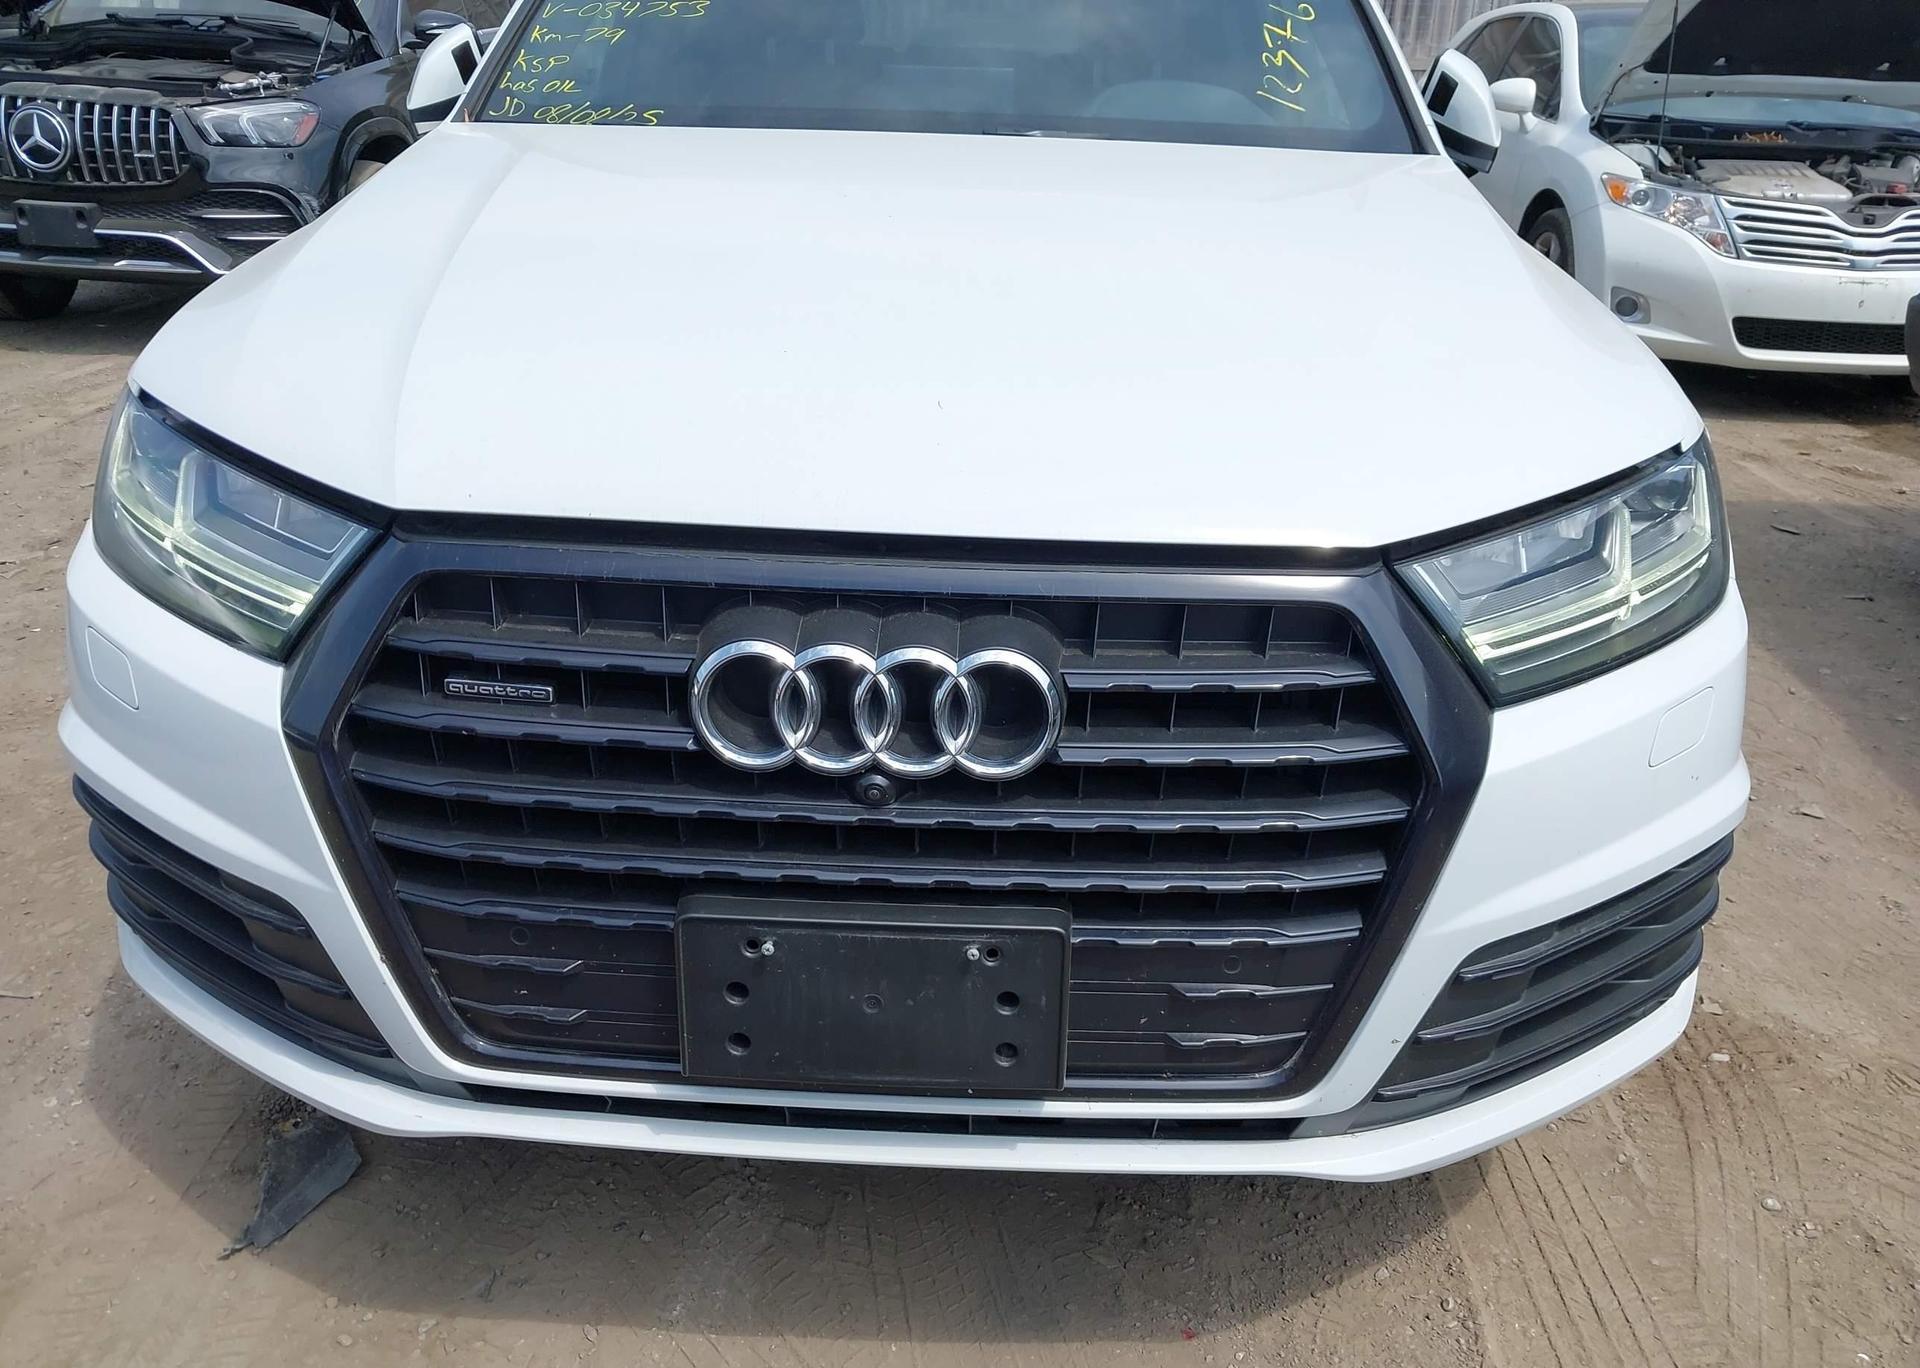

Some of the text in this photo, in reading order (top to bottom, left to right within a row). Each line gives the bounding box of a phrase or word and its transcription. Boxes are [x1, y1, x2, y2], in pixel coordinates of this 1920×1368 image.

[500, 71, 540, 93] has
[488, 96, 526, 117] JD
[448, 682, 547, 699] quattro
